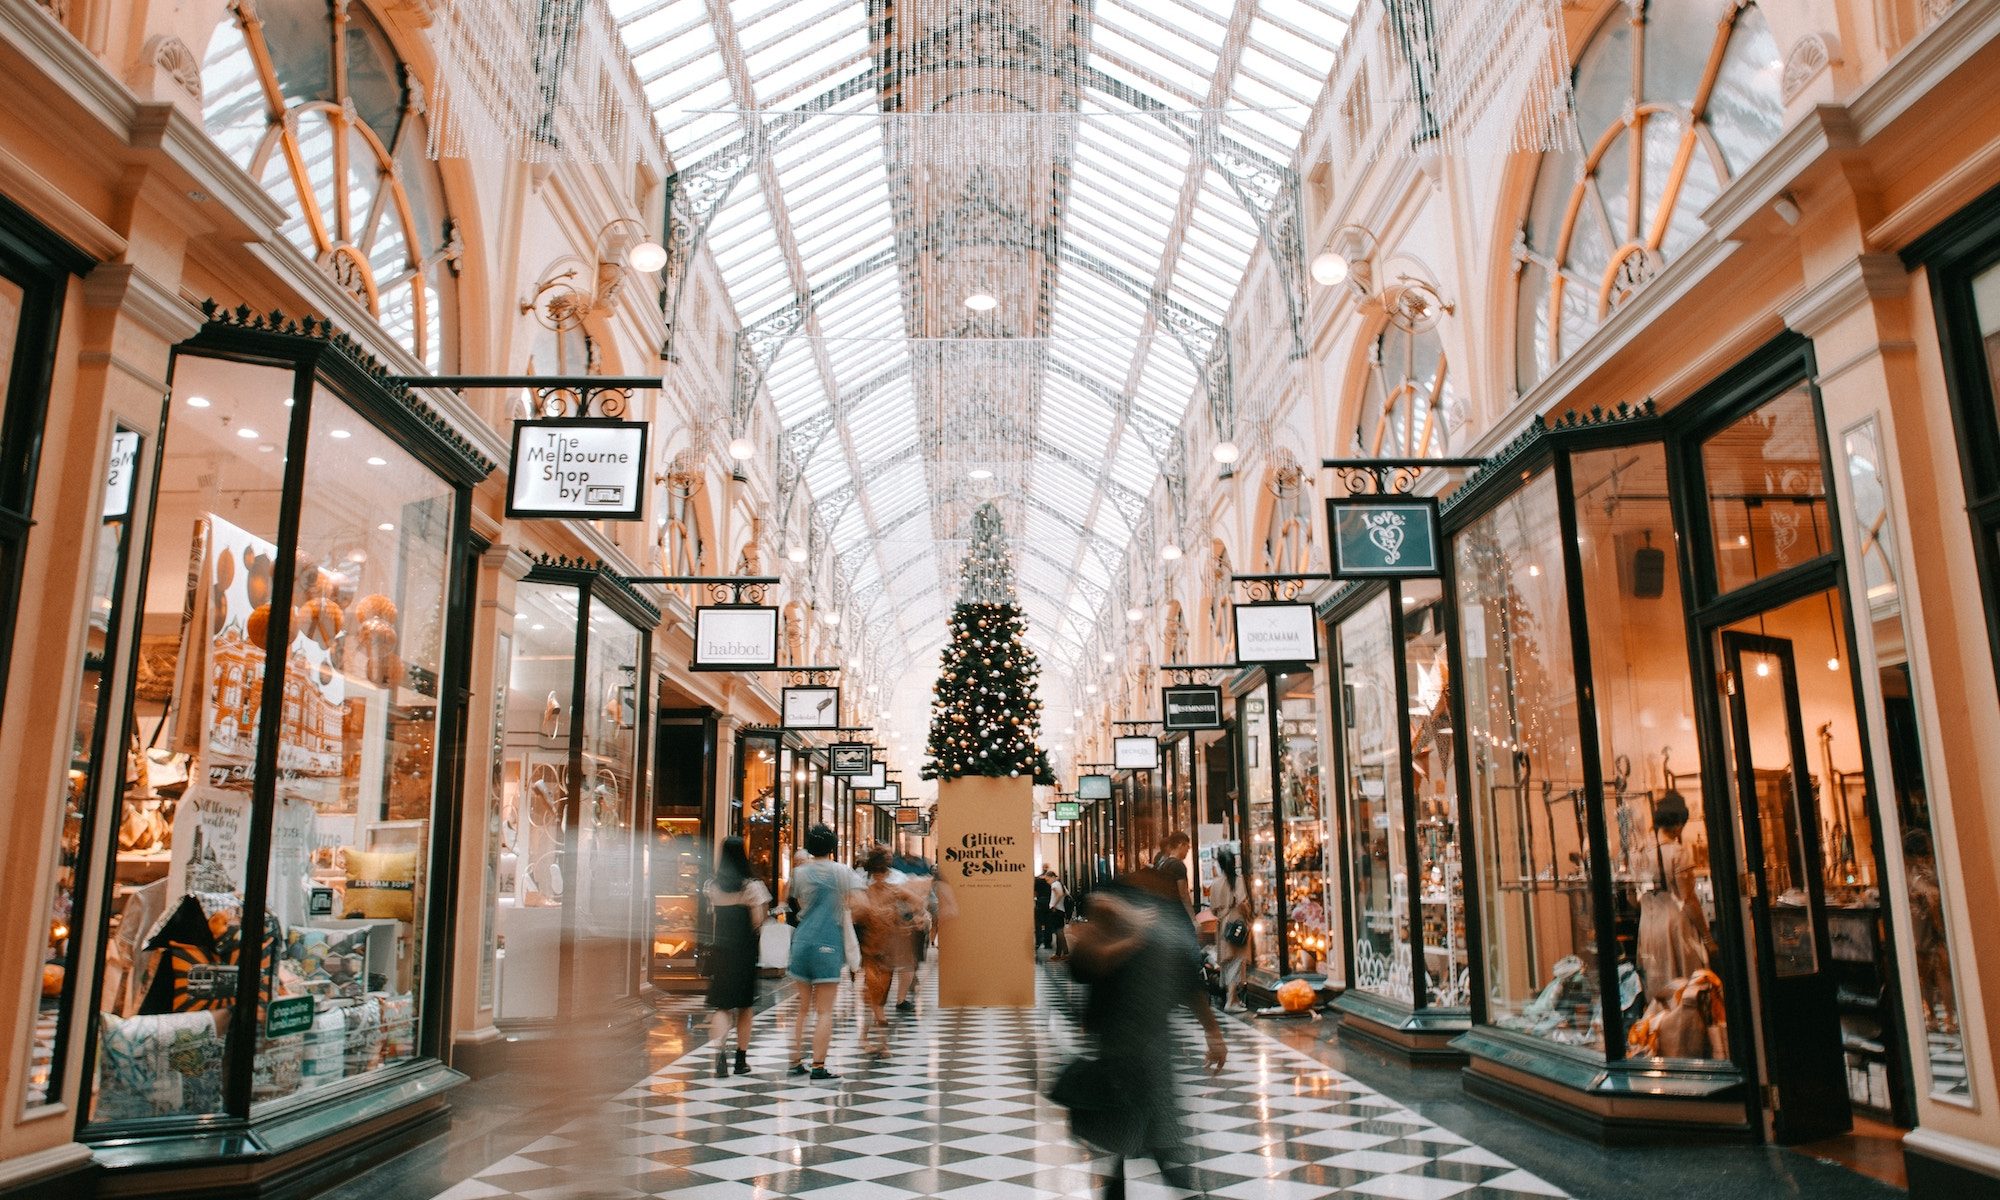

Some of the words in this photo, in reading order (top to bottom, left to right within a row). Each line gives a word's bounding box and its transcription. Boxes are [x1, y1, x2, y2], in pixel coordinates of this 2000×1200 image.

[547, 433, 579, 449] The
[527, 447, 629, 465] Melbourne
[543, 465, 590, 485] Shop
[560, 485, 582, 502] by
[708, 641, 764, 656] habbot.
[962, 832, 1015, 849] Glitter.
[945, 846, 1004, 862] Sparkle
